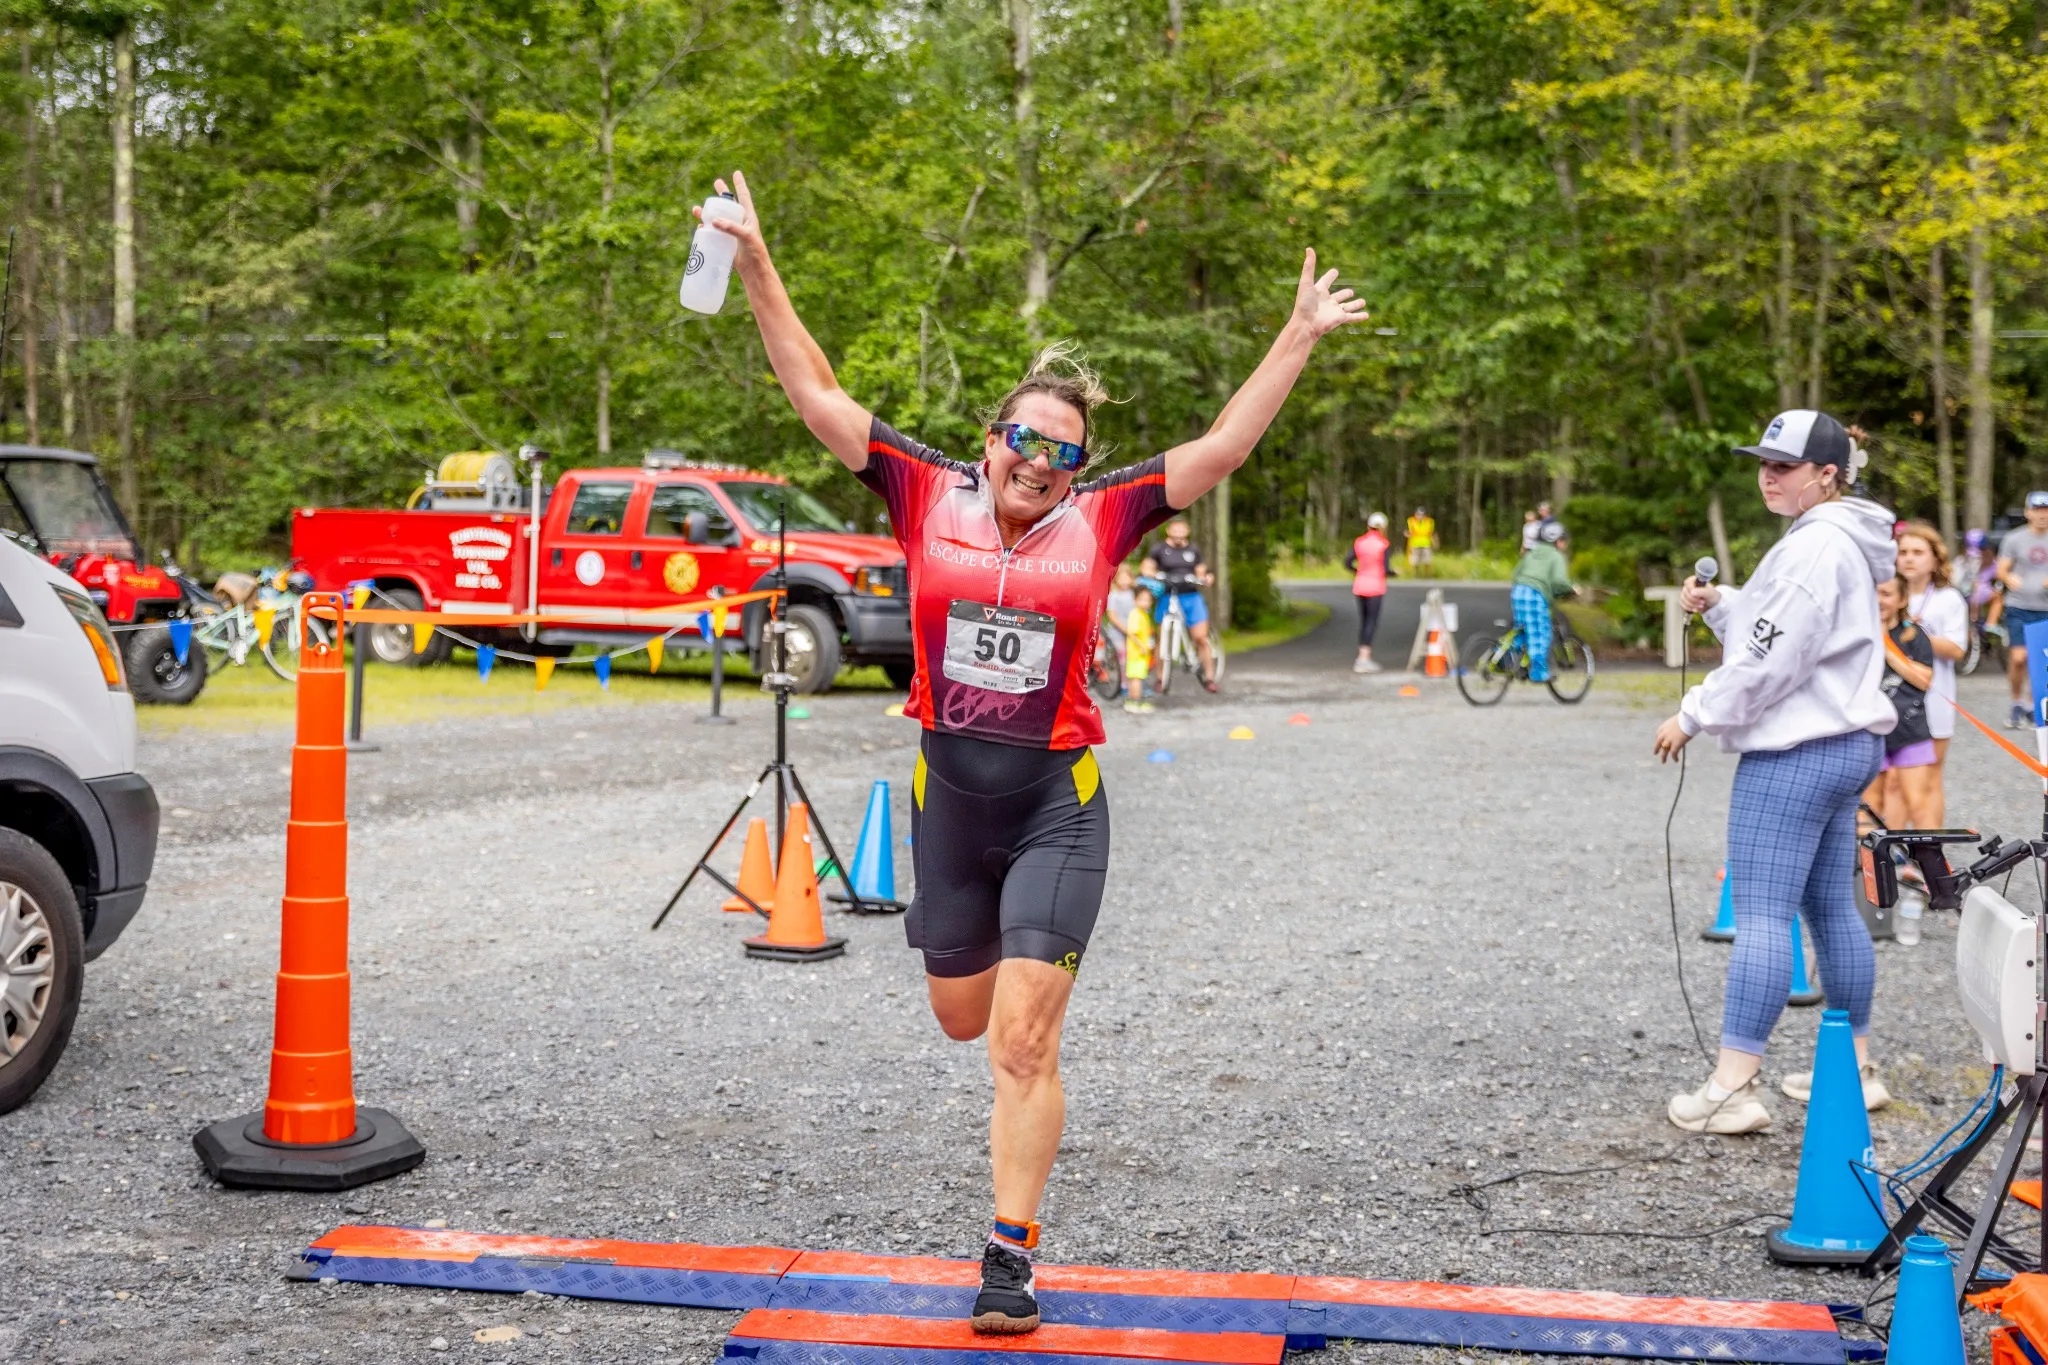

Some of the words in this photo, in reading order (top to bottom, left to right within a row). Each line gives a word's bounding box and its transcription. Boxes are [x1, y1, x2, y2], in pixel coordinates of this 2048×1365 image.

[928, 541, 977, 567] ESCAPE
[981, 554, 1034, 573] CYCLE
[1038, 559, 1087, 574] TOURS
[974, 628, 1021, 665] 50
